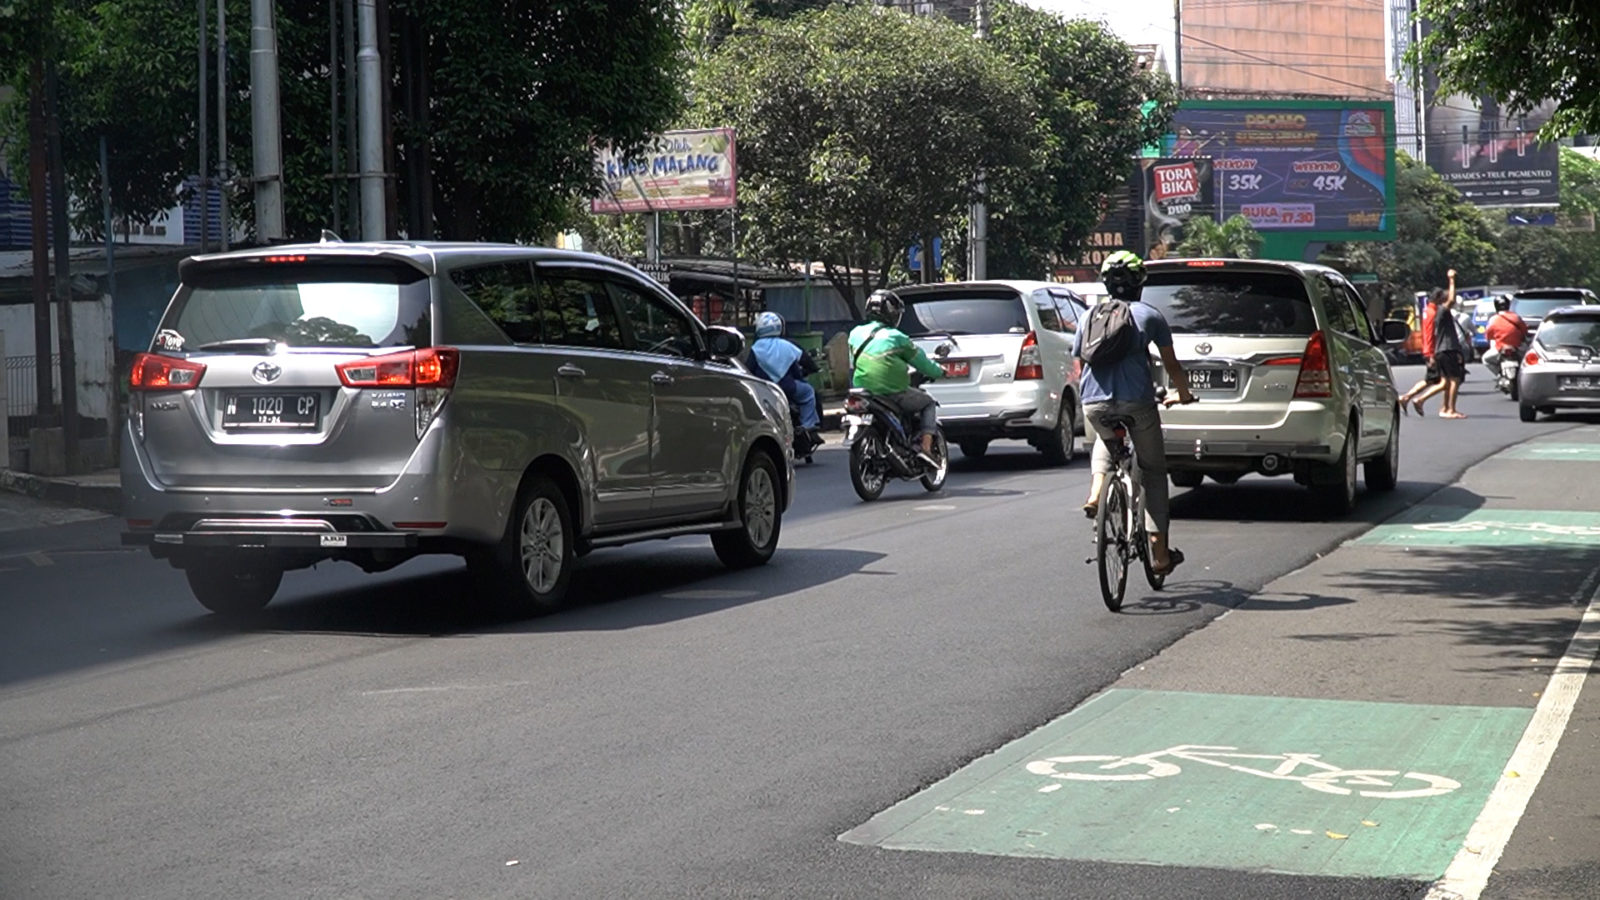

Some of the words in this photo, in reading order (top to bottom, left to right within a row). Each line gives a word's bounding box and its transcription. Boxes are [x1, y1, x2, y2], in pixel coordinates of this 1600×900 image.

[652, 154, 719, 175] MALANG
[1158, 167, 1193, 182] TORA
[1450, 171, 1481, 180] SHADES
[1487, 170, 1507, 179] TRUE
[1507, 169, 1552, 178] PIGMENTED
[1161, 180, 1194, 195] BIKA
[1228, 174, 1263, 191] 35K
[1313, 175, 1347, 191] 45K
[1167, 203, 1192, 216] DUO
[1243, 206, 1279, 218] BUKA
[1187, 370, 1212, 383] 1697
[227, 398, 237, 415] N
[252, 397, 284, 415] 1020
[297, 396, 315, 415] CP
